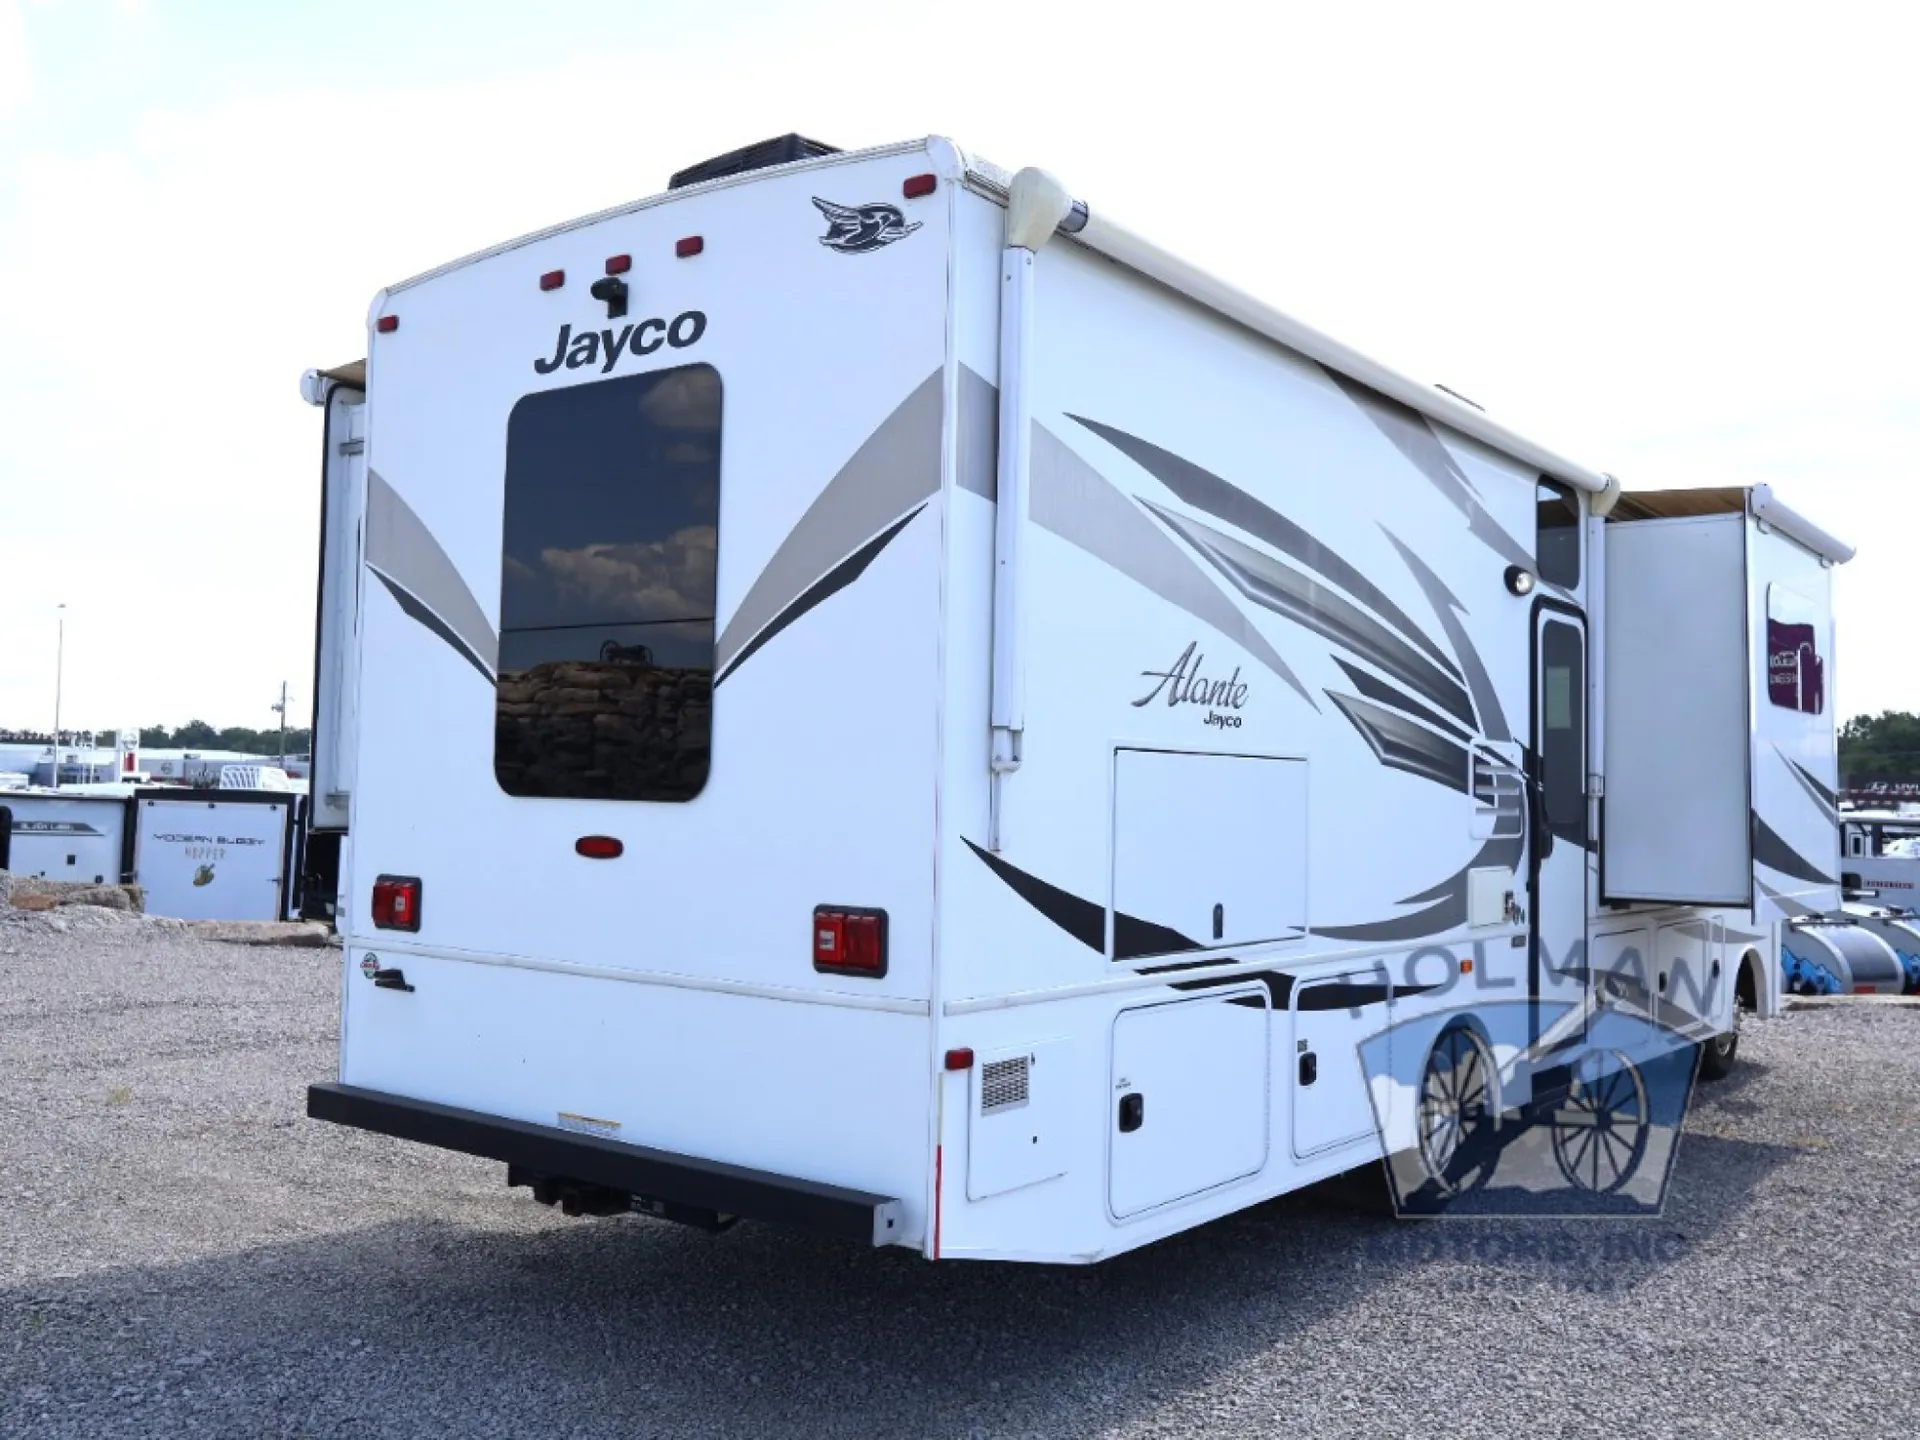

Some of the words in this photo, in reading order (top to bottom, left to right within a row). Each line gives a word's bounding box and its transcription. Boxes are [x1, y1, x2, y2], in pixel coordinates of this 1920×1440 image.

[534, 310, 707, 374] Jayco
[1131, 641, 1250, 709] Alante
[1203, 711, 1242, 729] Jayco
